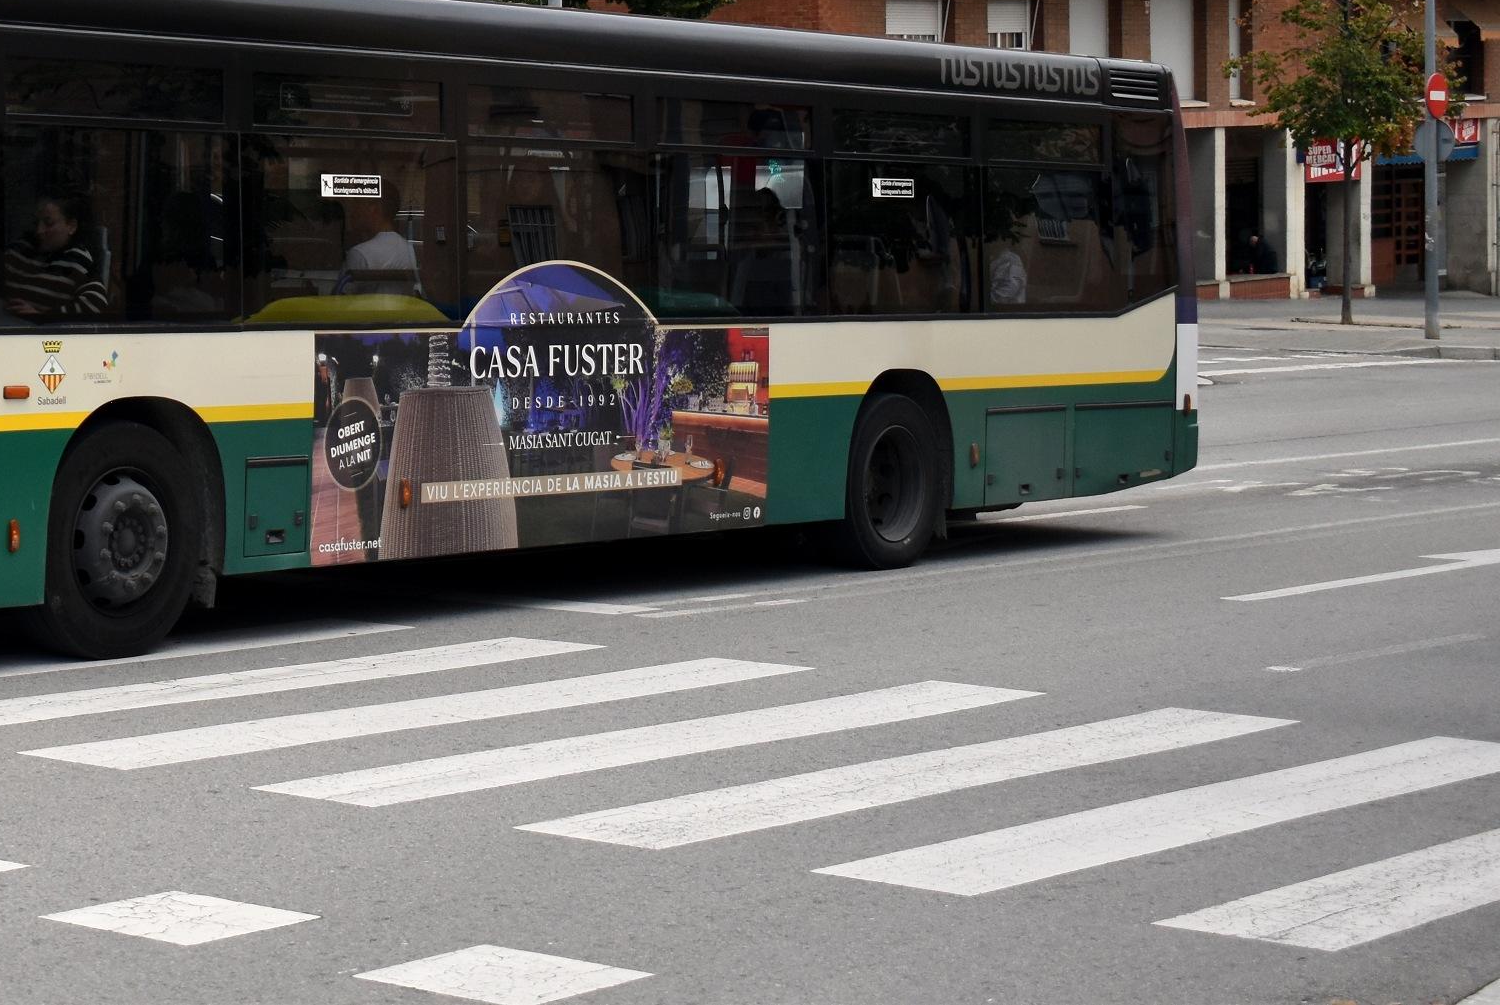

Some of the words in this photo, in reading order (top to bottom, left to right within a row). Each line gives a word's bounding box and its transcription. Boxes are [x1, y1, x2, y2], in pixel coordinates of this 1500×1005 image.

[1305, 154, 1336, 165] MERCAT
[1308, 145, 1332, 155] SUPER
[510, 312, 620, 325] RESTAURANTES
[469, 345, 540, 379] CASA
[548, 343, 644, 377] FUSTER
[37, 396, 67, 406] Sabadell
[337, 420, 365, 439] OBERT
[330, 432, 376, 458] DIUMENGE
[509, 434, 543, 450] MASIA
[545, 432, 574, 448] SANT
[575, 430, 612, 447] CUGAT
[339, 459, 345, 470] A
[346, 456, 356, 467] LA
[356, 449, 371, 464] NIT
[427, 485, 448, 501] VIU
[453, 480, 543, 499] L'EXPERIÈNCIA
[547, 478, 562, 492] DE
[566, 476, 580, 491] LA
[584, 473, 622, 489] MASIA
[625, 473, 633, 487] A
[637, 470, 678, 486] L'ESTIU
[318, 536, 382, 553] casafuster.net
